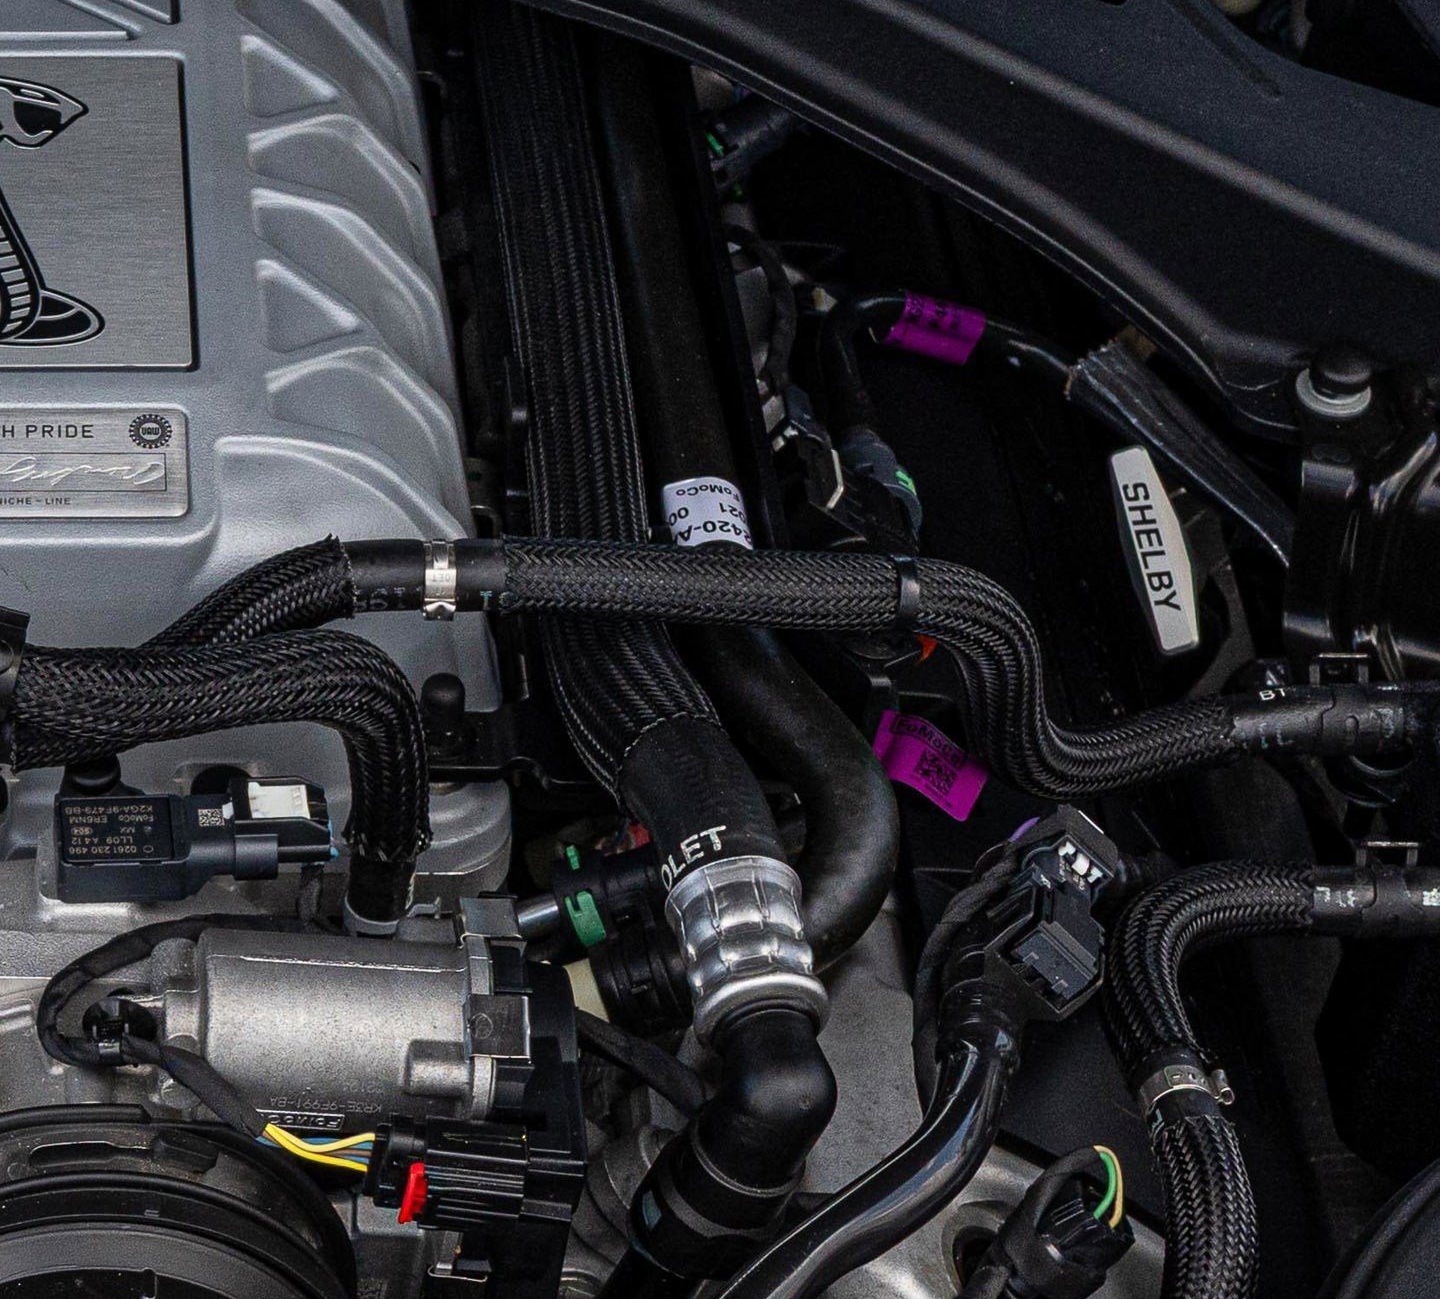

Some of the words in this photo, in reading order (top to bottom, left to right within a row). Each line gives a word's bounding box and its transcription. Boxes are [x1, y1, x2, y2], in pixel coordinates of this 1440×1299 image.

[25, 424, 95, 439] PRIDE
[676, 484, 741, 503] FoMoCo
[45, 497, 71, 506] LINE
[1119, 481, 1181, 614] SHELBY
[118, 814, 154, 822] FoMoCo
[91, 845, 111, 854] 230
[113, 845, 137, 854] 0261
